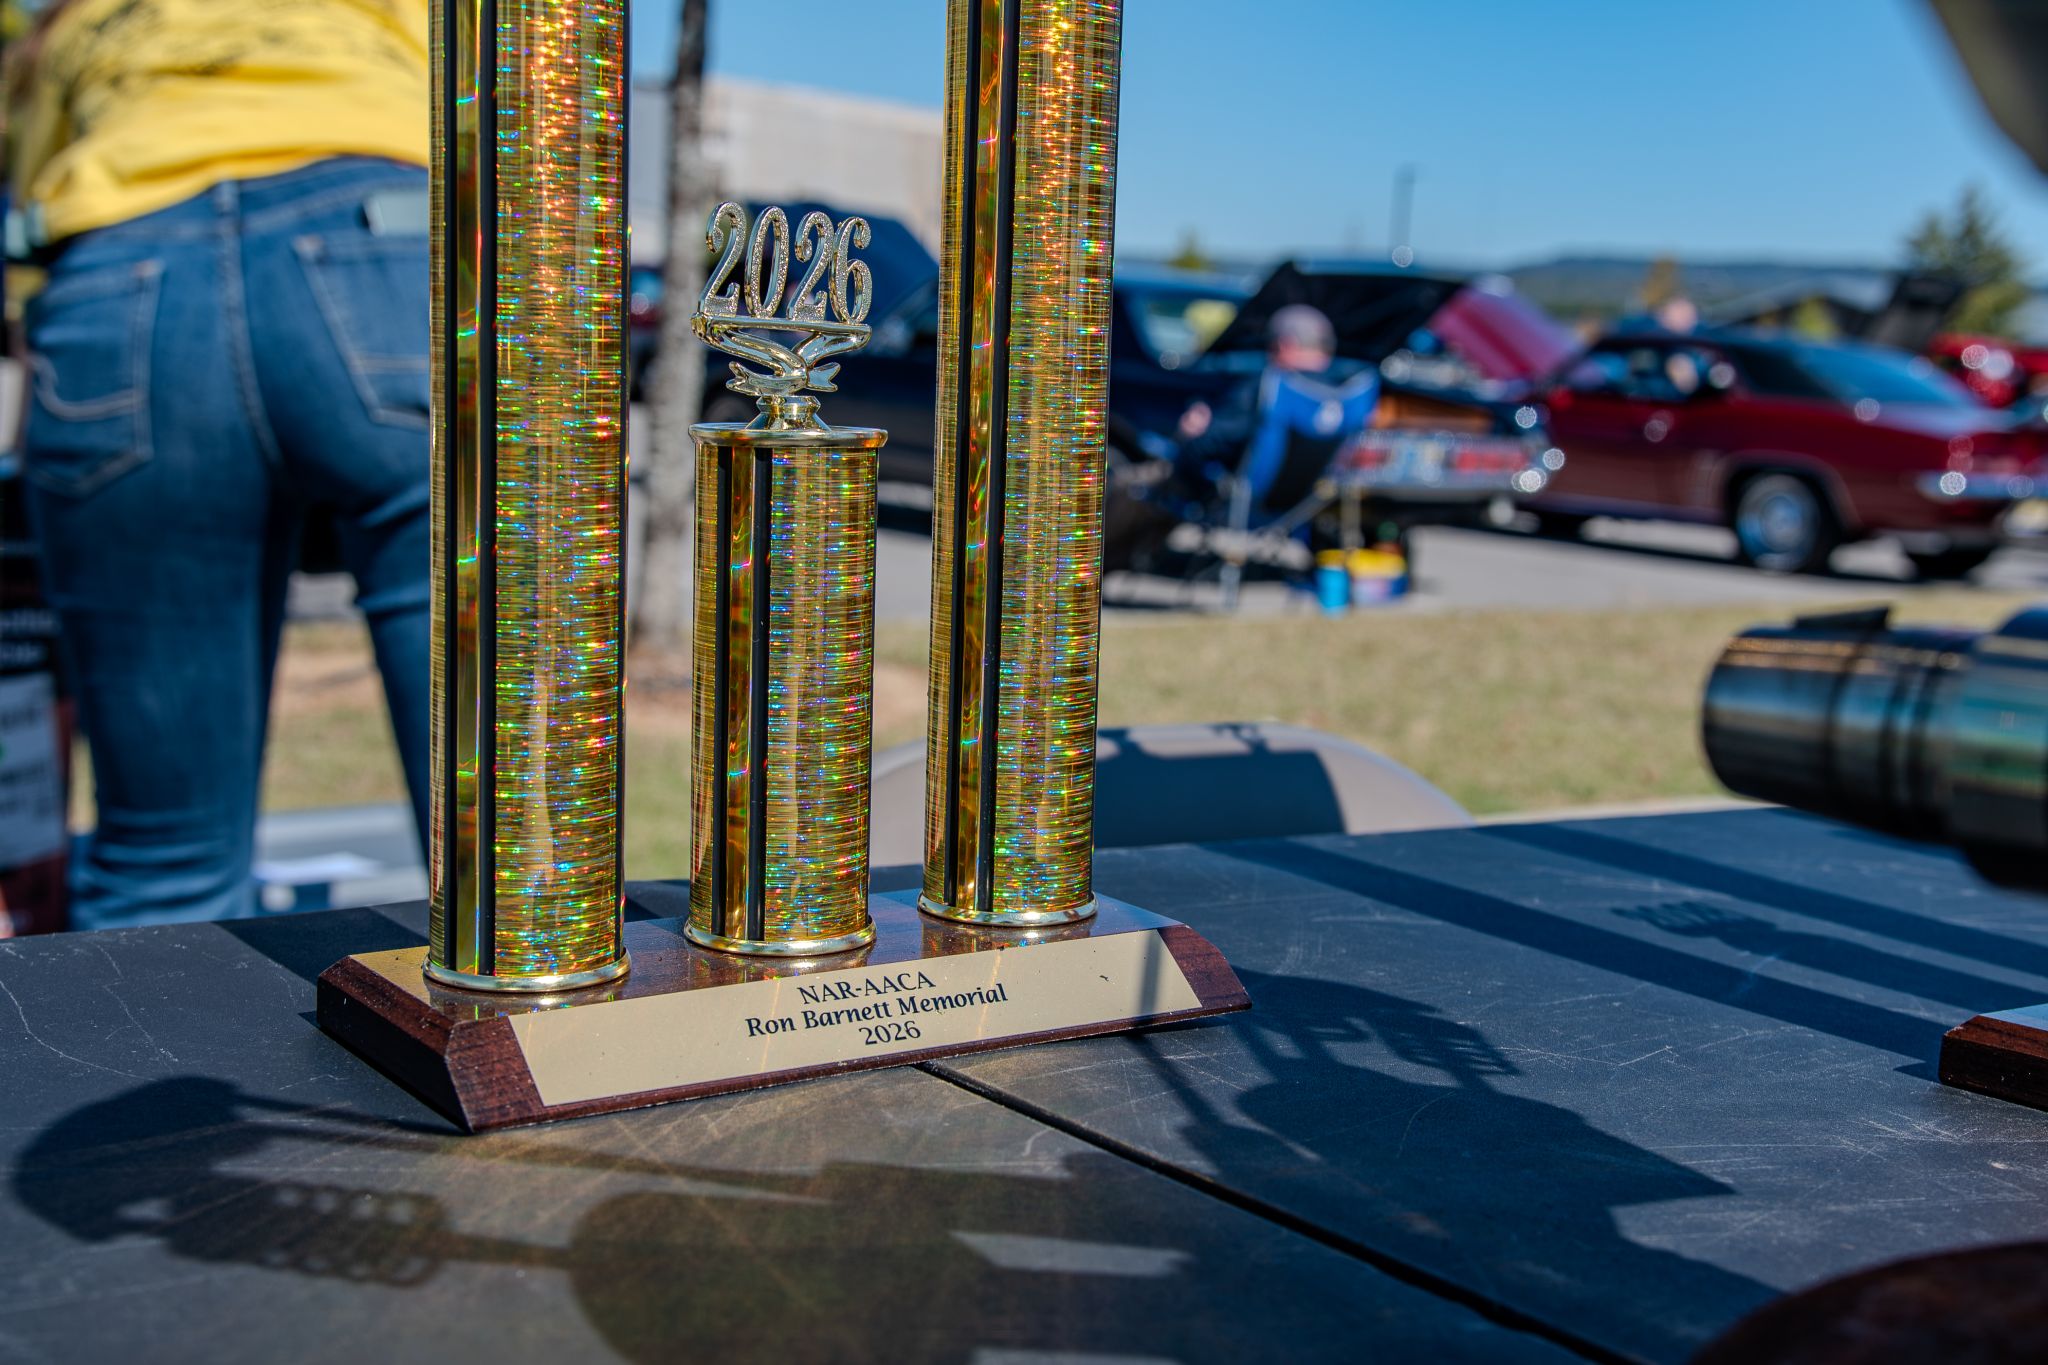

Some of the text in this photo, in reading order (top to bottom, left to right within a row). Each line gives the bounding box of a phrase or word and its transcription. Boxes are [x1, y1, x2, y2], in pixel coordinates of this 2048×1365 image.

[698, 201, 872, 324] 2026
[797, 971, 936, 1004] NAR-AACA
[745, 983, 1008, 1037] Ron Barnett Memorial
[859, 1020, 921, 1046] 2026
